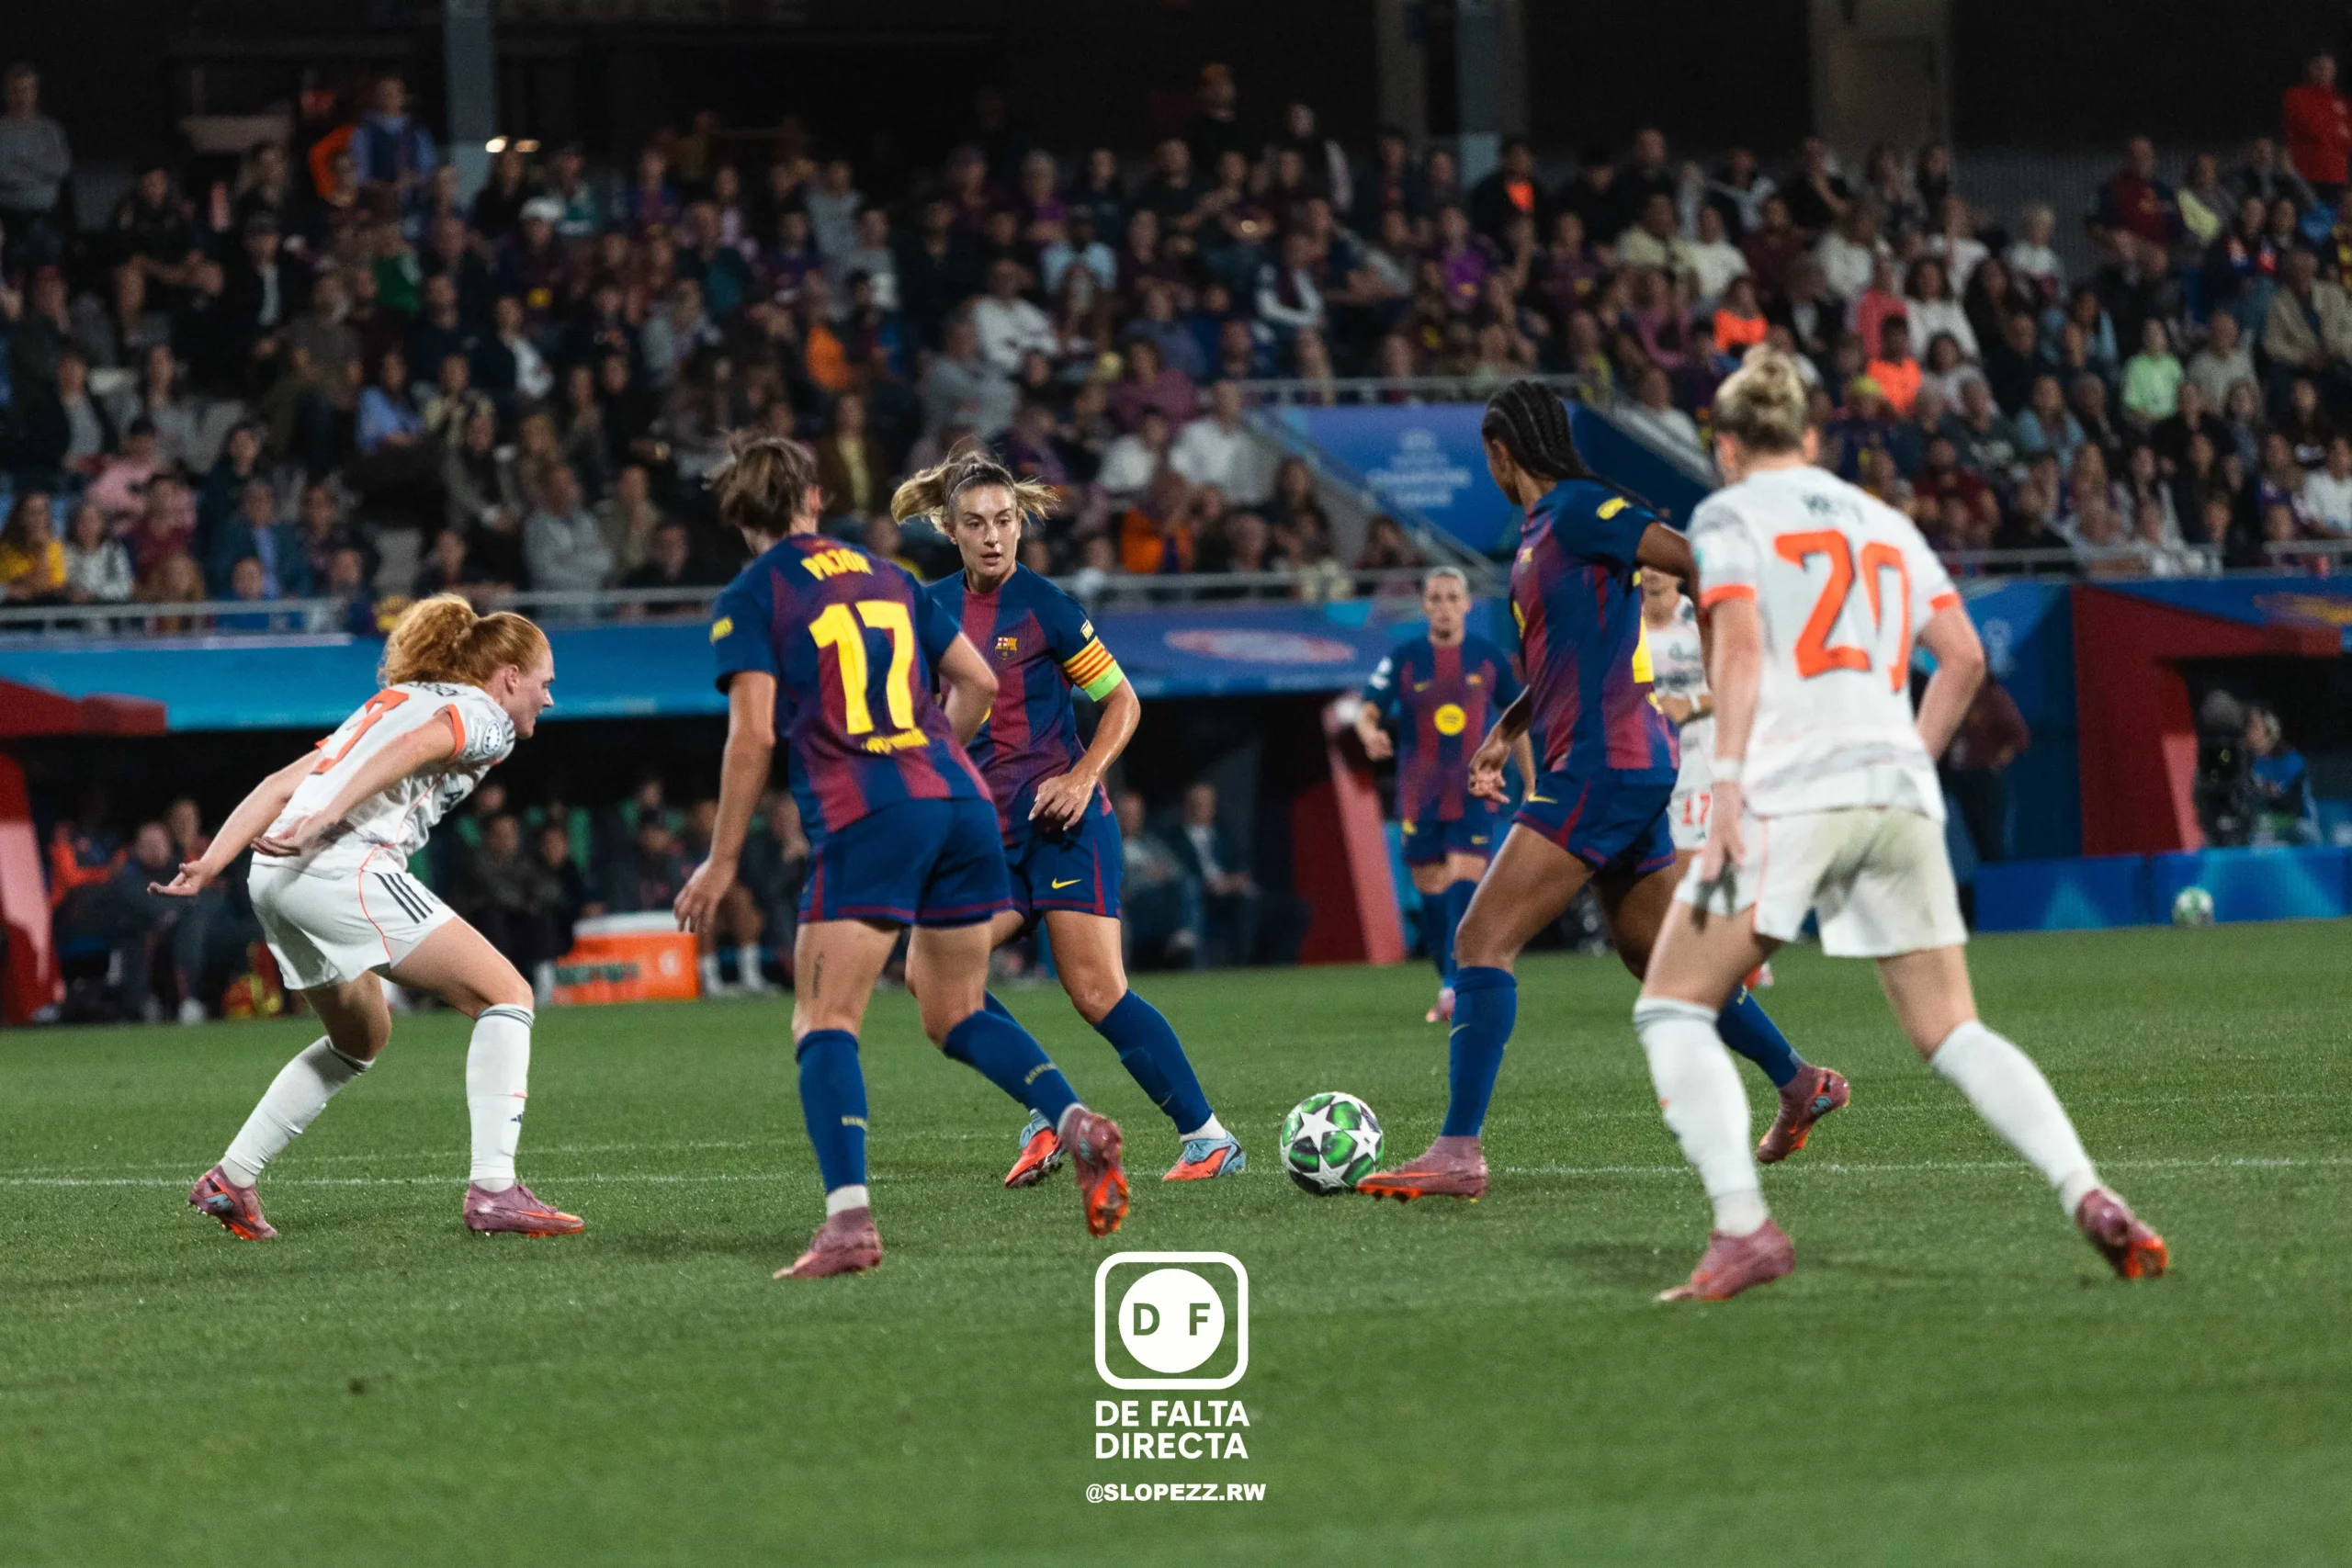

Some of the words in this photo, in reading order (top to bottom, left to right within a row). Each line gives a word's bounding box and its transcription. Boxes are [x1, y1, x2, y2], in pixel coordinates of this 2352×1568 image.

[808, 600, 914, 735] 17
[1774, 529, 1911, 693] 20
[1682, 793, 1712, 825] 17
